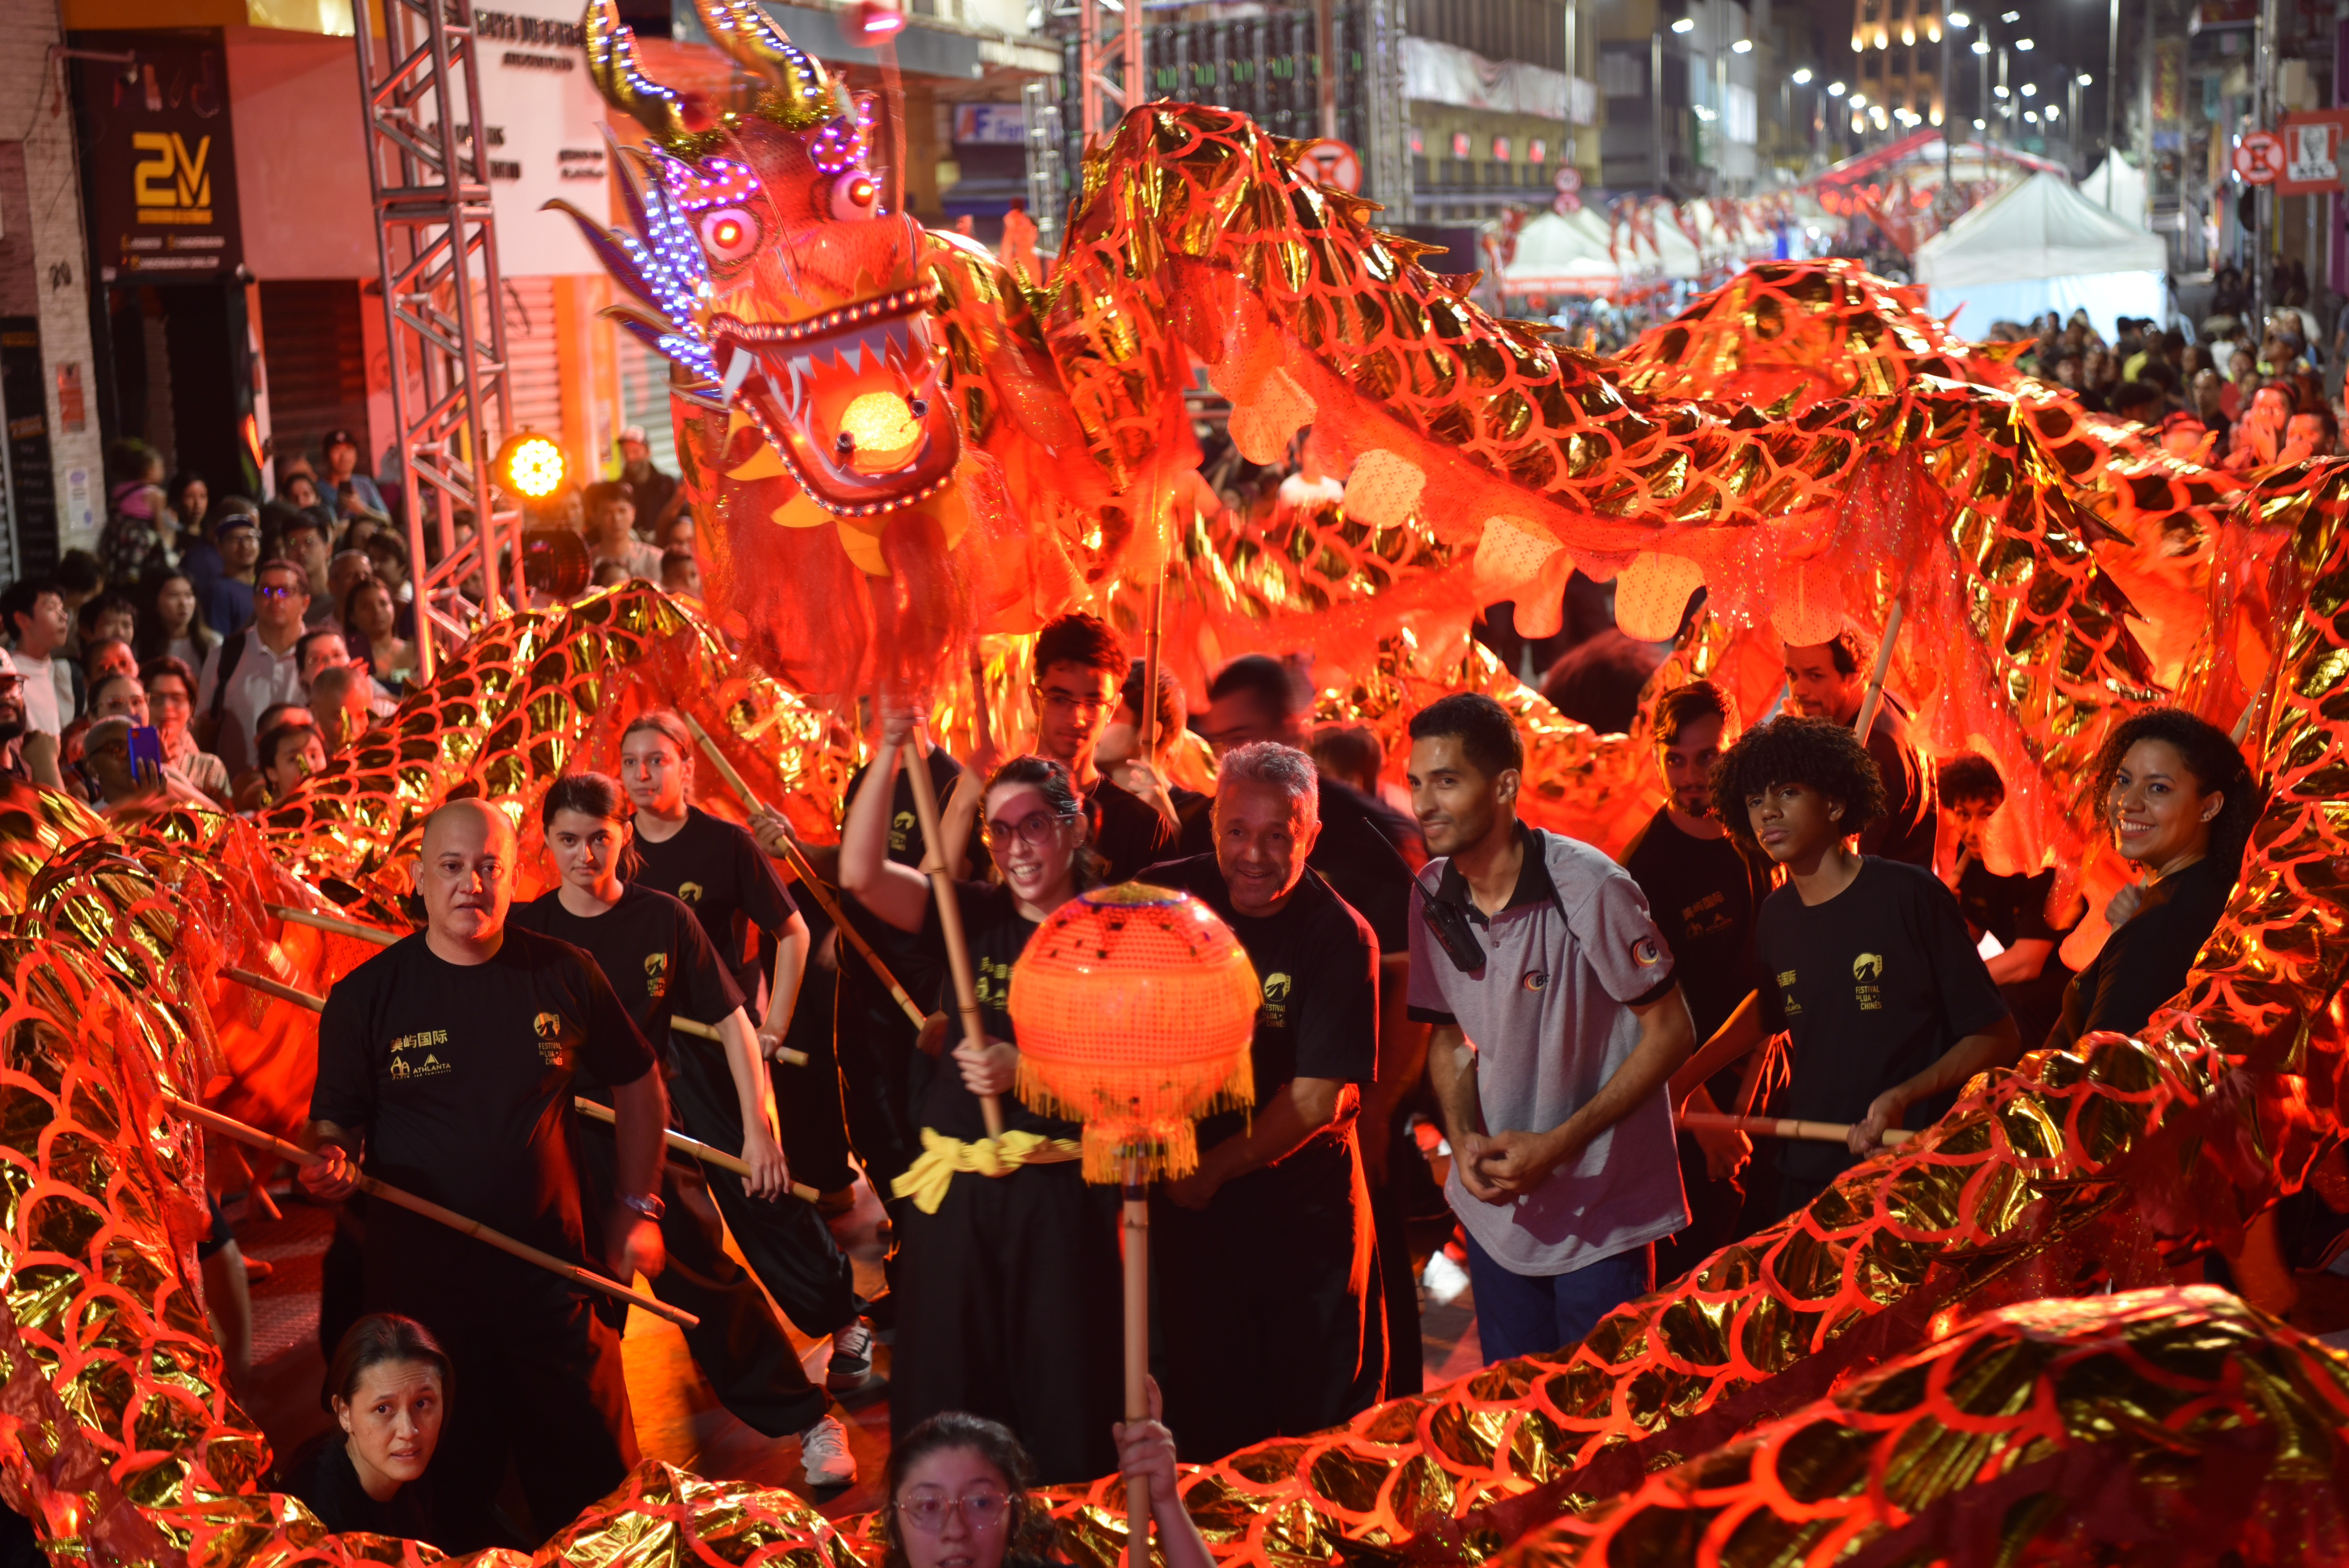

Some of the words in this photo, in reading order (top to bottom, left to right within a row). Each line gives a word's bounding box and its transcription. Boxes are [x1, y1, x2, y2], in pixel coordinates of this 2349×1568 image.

[1856, 985, 1880, 994] FESTIVAL
[1861, 1001, 1882, 1010] CHINÊS
[1267, 1019, 1286, 1027] CHINÊS
[390, 1030, 447, 1053] 美屿国际
[546, 1056, 562, 1065] CHINÊS
[413, 1063, 451, 1074] ATHLANTA
